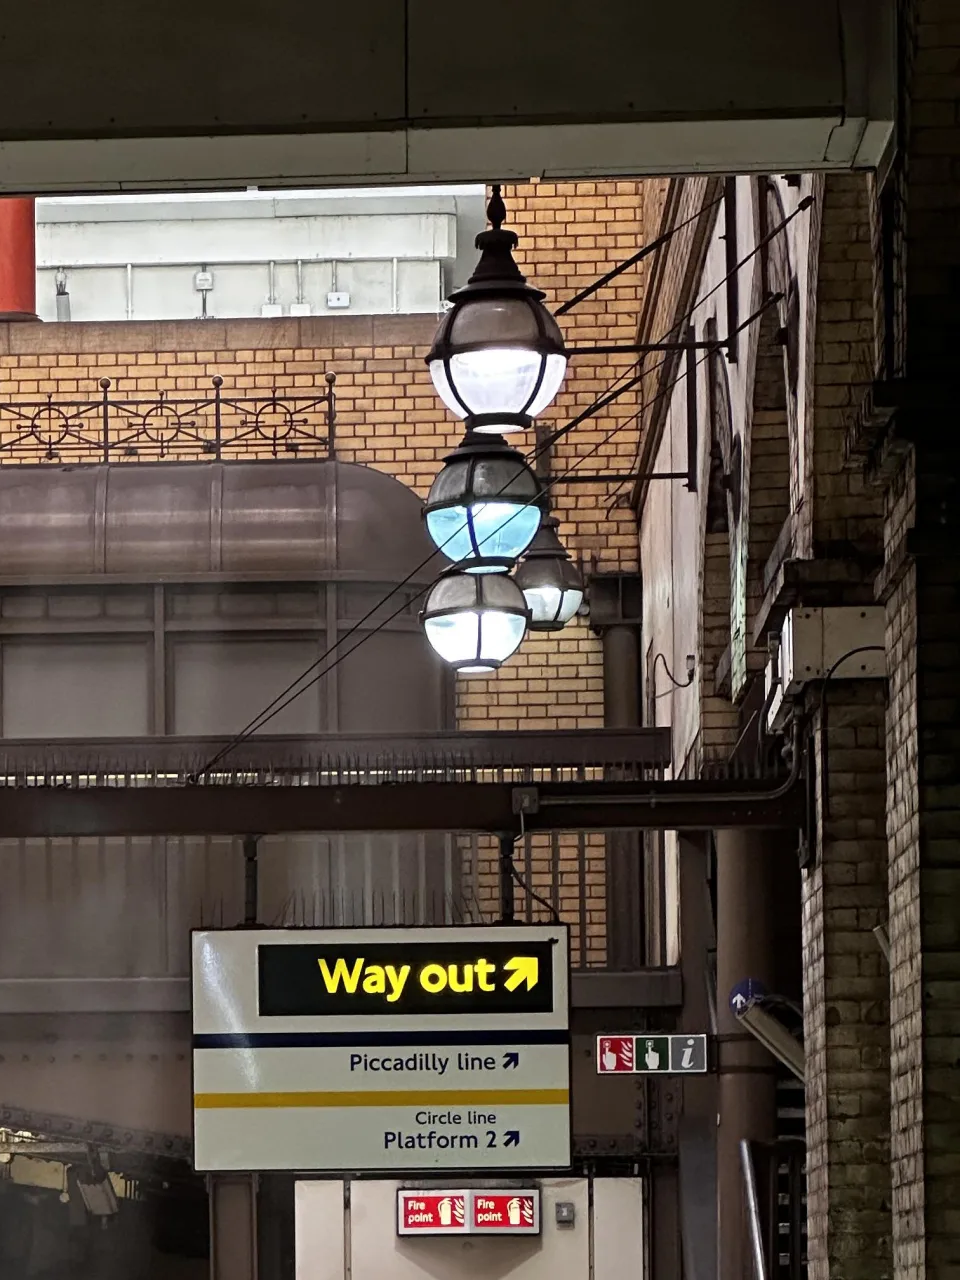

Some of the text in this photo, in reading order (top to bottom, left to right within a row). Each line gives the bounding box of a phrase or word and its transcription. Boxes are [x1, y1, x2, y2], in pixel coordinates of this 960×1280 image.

[317, 957, 496, 1002] Way out
[350, 1052, 496, 1075] Piccadilly line
[415, 1111, 497, 1125] Circle line
[384, 1130, 497, 1149] Platform 2
[408, 1200, 426, 1211] Fire
[477, 1199, 495, 1210] Fire
[408, 1213, 434, 1225] point
[477, 1212, 503, 1224] point
